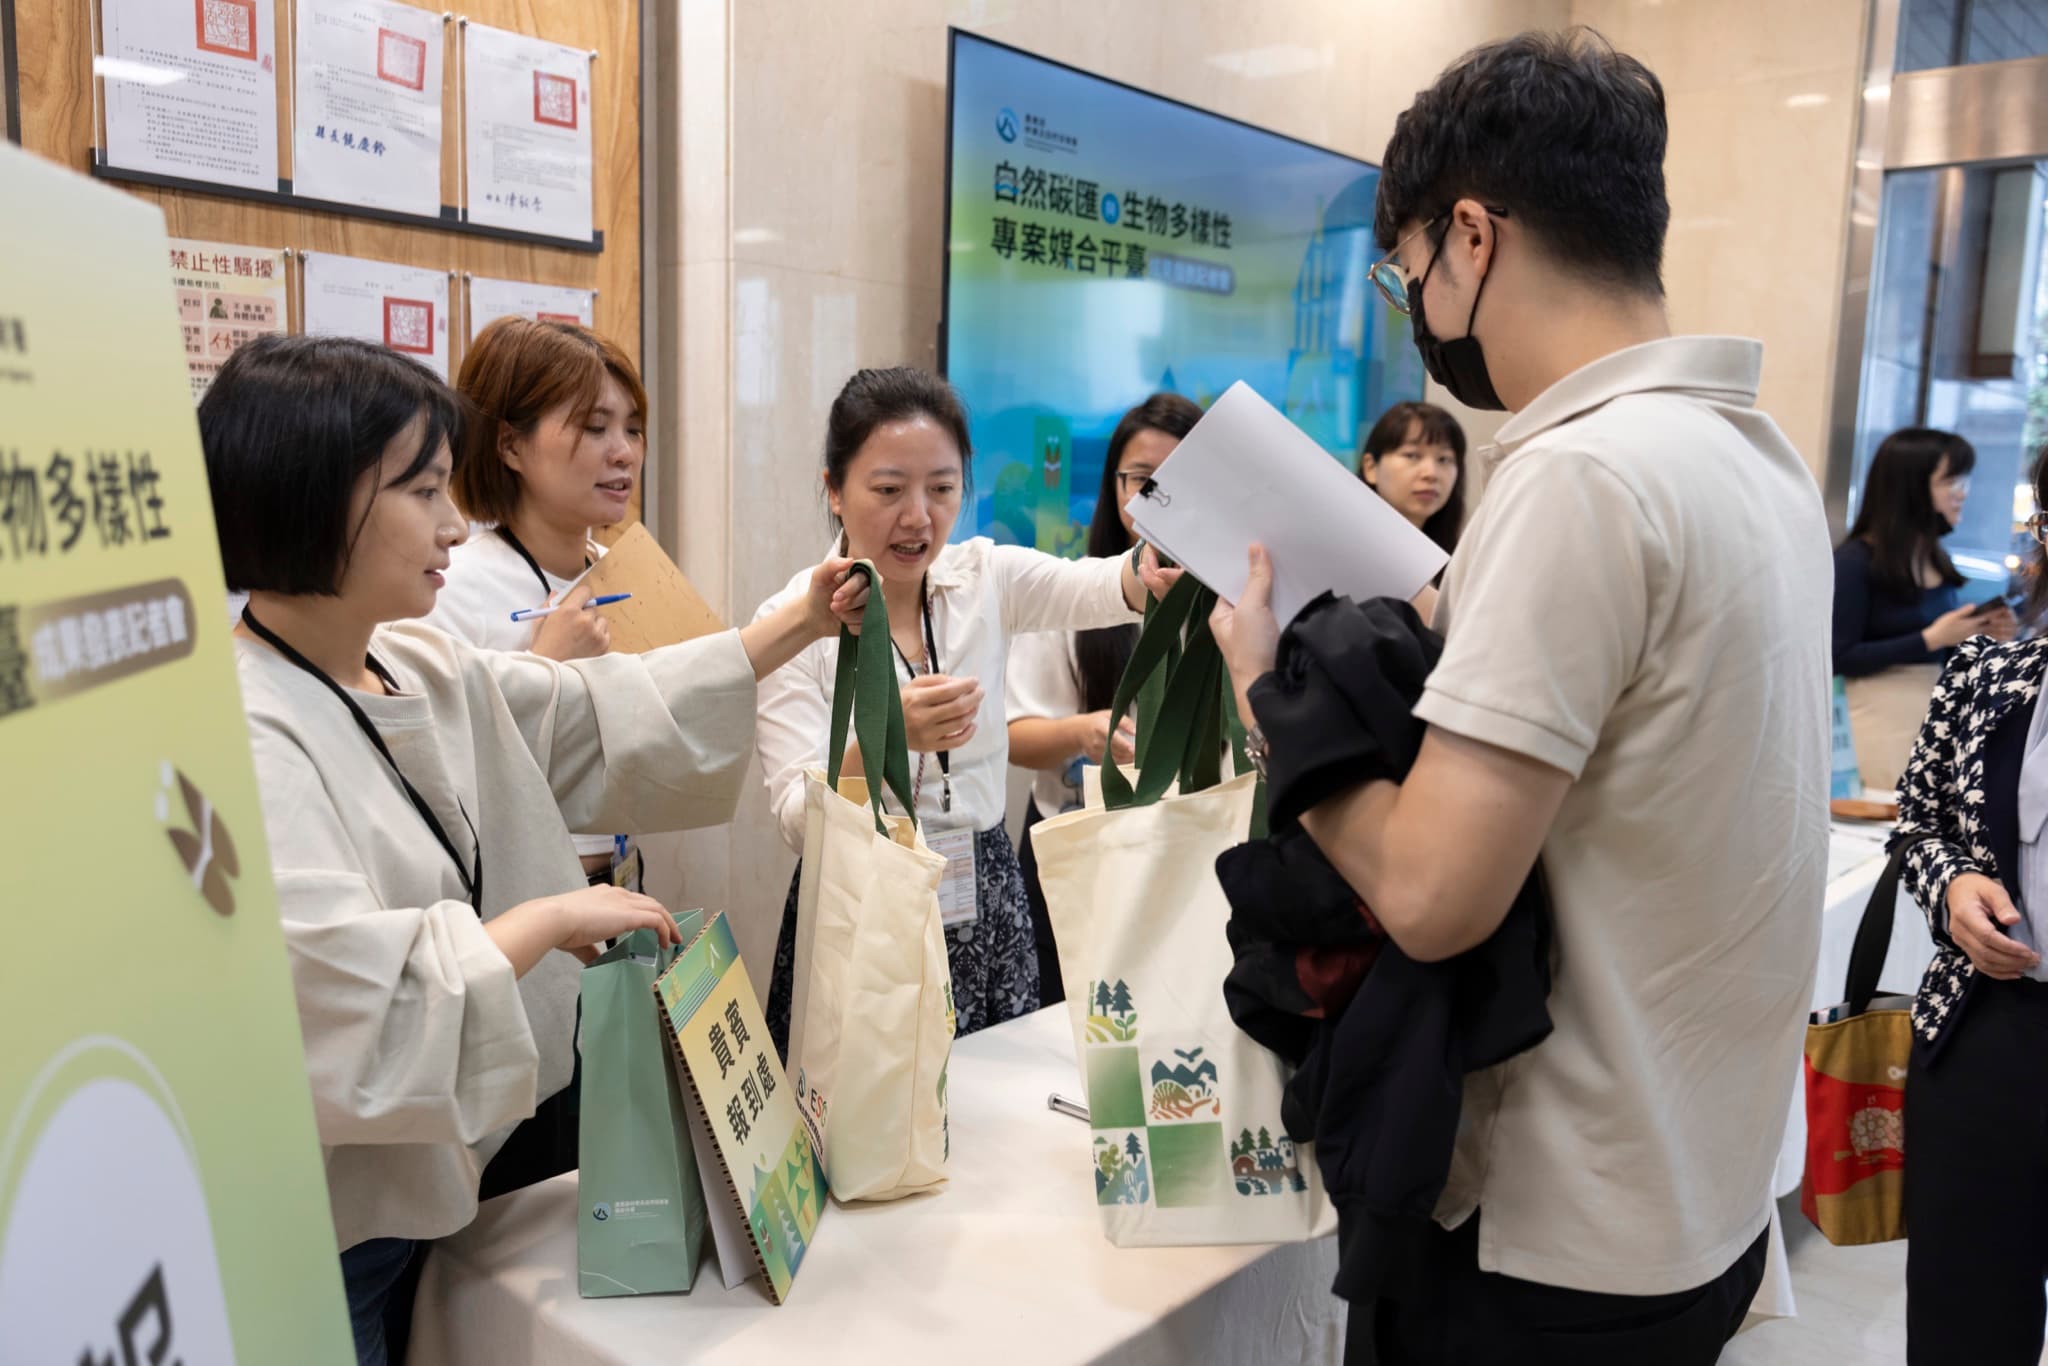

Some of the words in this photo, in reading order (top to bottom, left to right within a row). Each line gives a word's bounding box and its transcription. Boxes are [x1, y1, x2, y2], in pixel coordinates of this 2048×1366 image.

[0, 448, 171, 562] 物多樣性
[708, 998, 750, 1081] 貴賓
[726, 1051, 776, 1146] 報到處
